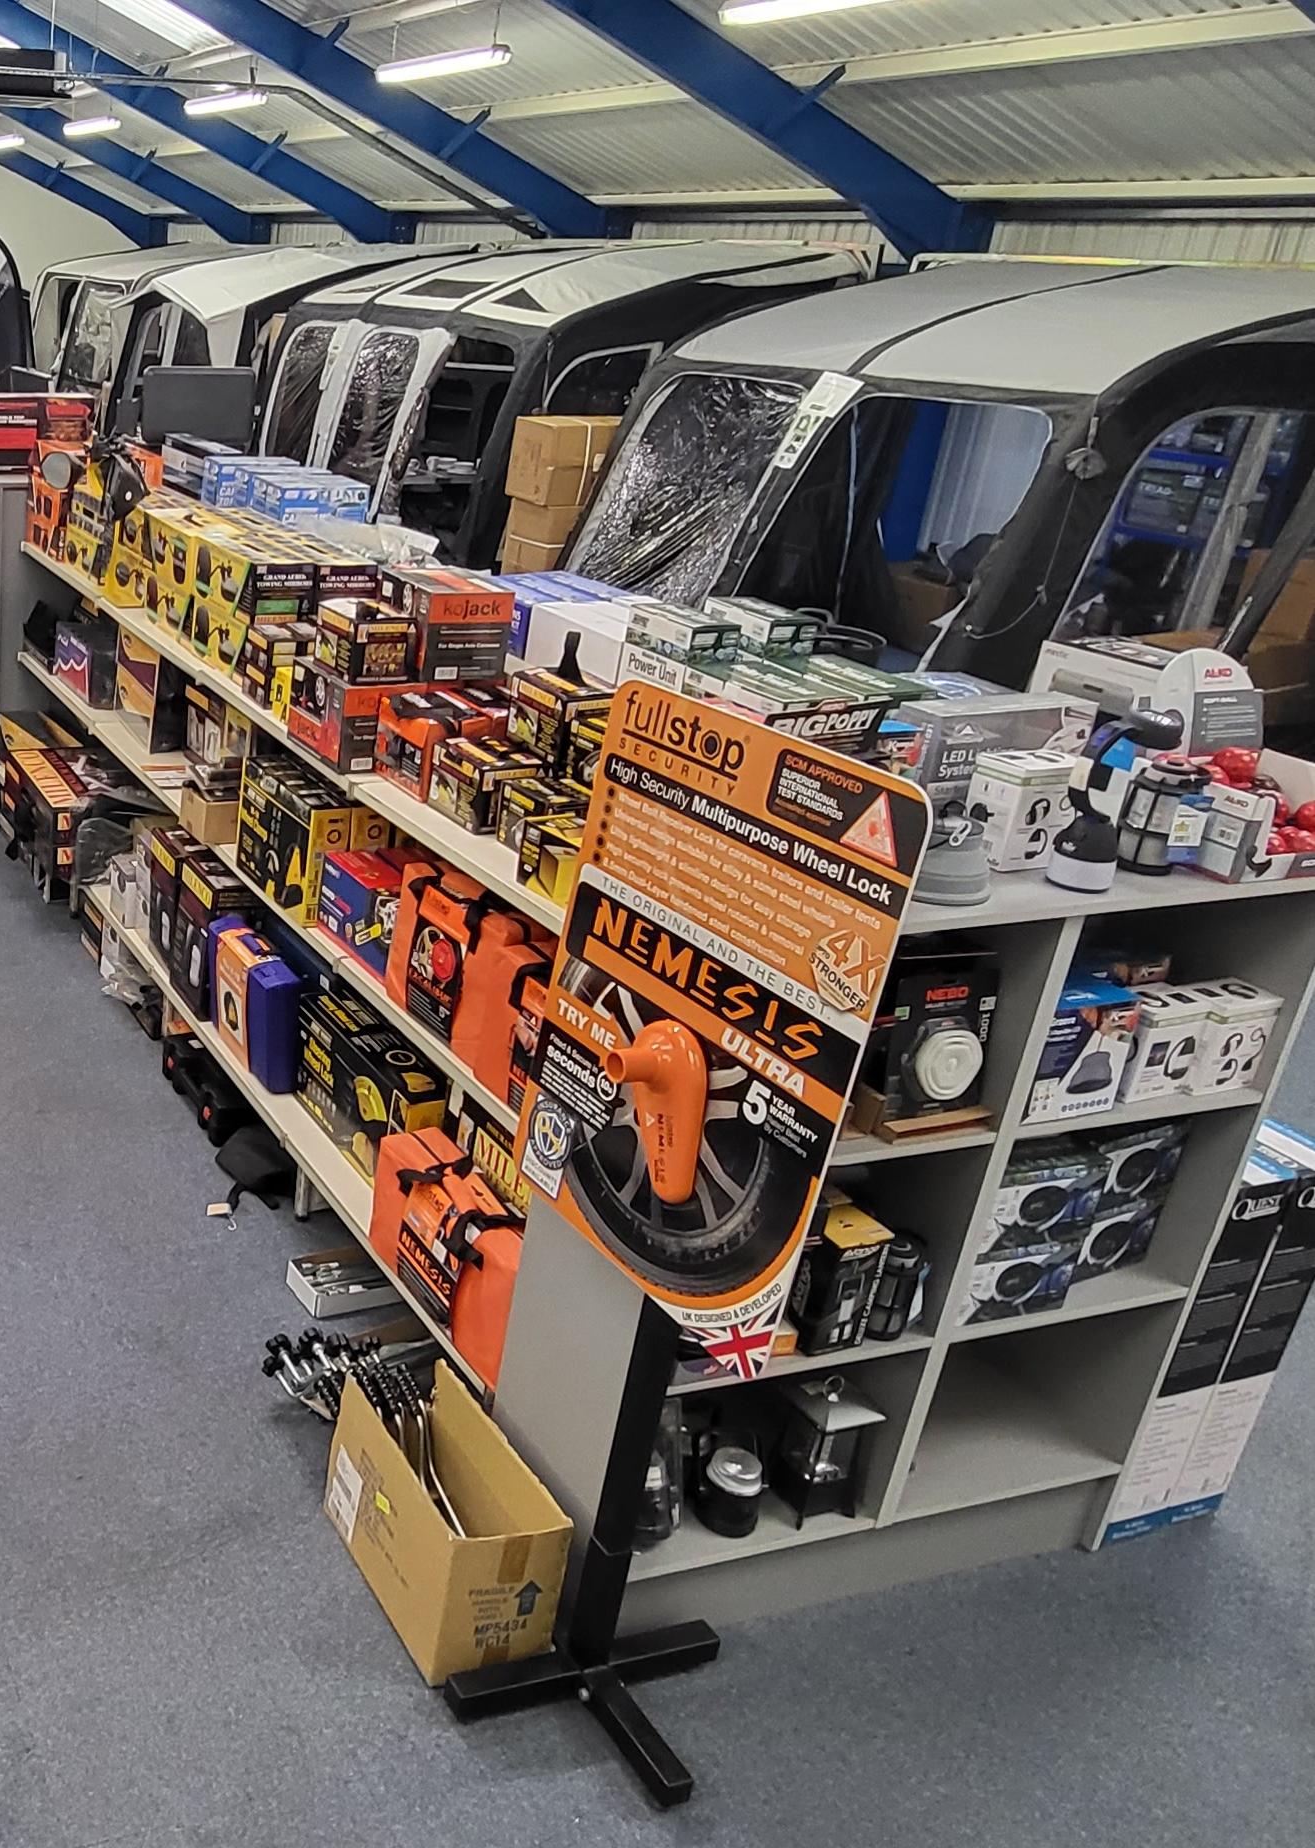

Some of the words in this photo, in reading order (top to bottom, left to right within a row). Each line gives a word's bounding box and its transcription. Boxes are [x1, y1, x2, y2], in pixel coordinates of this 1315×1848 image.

[628, 656, 658, 677] Power
[660, 662, 677, 685] Unit
[625, 690, 744, 772] fullstop
[618, 737, 736, 797] SECURITY
[784, 754, 809, 772] SCM
[809, 763, 863, 794] APPROVED
[942, 751, 967, 764] LED
[779, 777, 839, 809] INTERNATIONAL
[782, 768, 821, 790] SUPERIOR
[777, 785, 797, 801] TEST
[797, 794, 844, 821] STANDARDS
[610, 758, 638, 785] High
[639, 774, 690, 810] Security
[691, 794, 789, 856] Multipurpose
[792, 841, 845, 882] Wheel
[846, 868, 892, 906] Lock
[771, 866, 803, 890] trailers
[804, 885, 824, 900] and
[824, 893, 854, 915] trailer
[855, 908, 881, 930] tents
[779, 893, 801, 910] steel
[802, 904, 836, 928] wheels
[753, 902, 776, 920] easy
[776, 914, 812, 938] storage
[602, 876, 627, 899] THE
[632, 895, 702, 943] ORIGINAL
[706, 938, 739, 964] AND
[745, 957, 777, 986] THE
[783, 981, 832, 1020] BEST.
[730, 929, 786, 965] construction
[768, 931, 805, 956] removal
[593, 897, 823, 1061] NEMESIS
[809, 952, 867, 1012] STRONGER
[826, 930, 887, 997] 4X
[925, 986, 970, 1002] NEBO
[557, 998, 591, 1032] TRY
[589, 1020, 618, 1051] ME
[546, 1044, 596, 1089] seconds
[720, 1027, 804, 1097] ULTRA
[742, 1080, 772, 1125] 5
[772, 1095, 796, 1117] YEAR
[769, 1104, 818, 1142] WARRANTY
[529, 1138, 563, 1170] APPROVED
[1232, 1194, 1285, 1220] QUEST
[401, 1230, 452, 1297] NEMESIS
[863, 1279, 881, 1317] CAMPING
[874, 1243, 891, 1278] LANTERN
[682, 1311, 692, 1321] UK
[694, 1311, 732, 1323] DESIGNED
[733, 1310, 740, 1319] &
[740, 1283, 782, 1316] DEVELOPED
[468, 1586, 516, 1598] FRAGILE
[474, 1618, 527, 1637] MP5434
